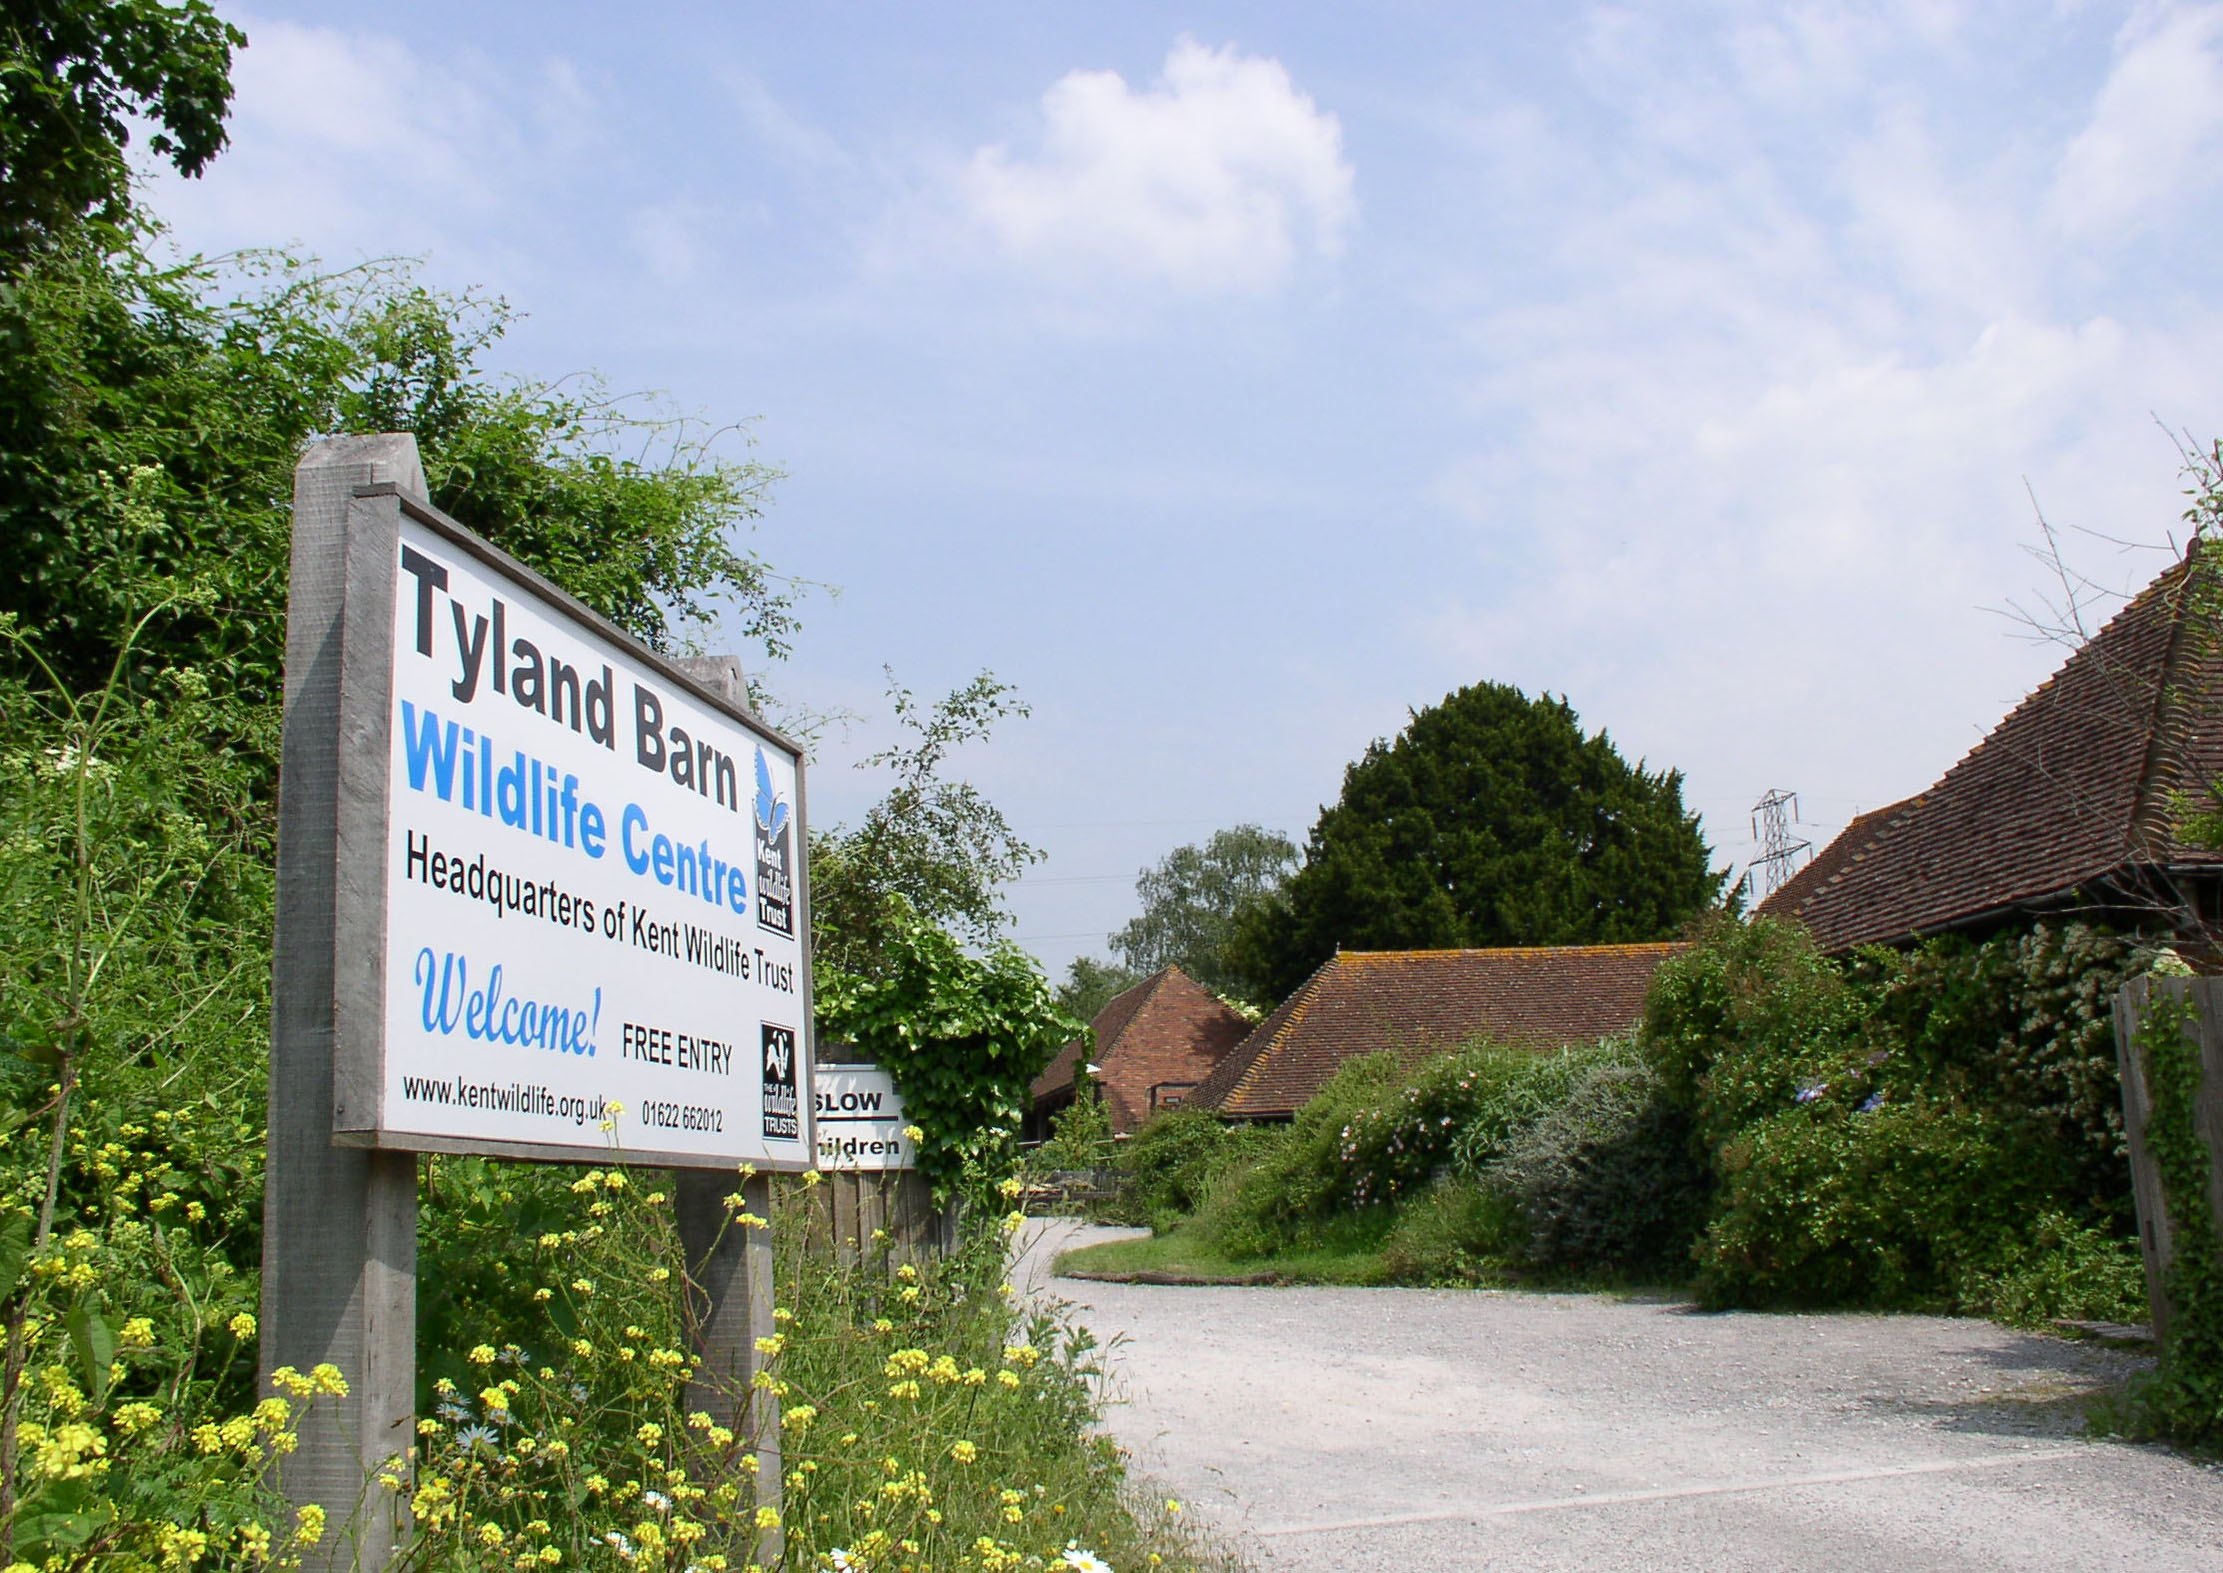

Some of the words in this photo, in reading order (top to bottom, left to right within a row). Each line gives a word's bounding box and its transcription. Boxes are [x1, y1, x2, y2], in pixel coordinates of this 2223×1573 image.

[402, 543, 615, 751] Tyland
[634, 683, 738, 812] Barn
[402, 700, 606, 859] Wildlife
[622, 803, 747, 914] Centre
[757, 838, 782, 870] Kent
[407, 829, 595, 933] Headquarters
[604, 901, 626, 941] of
[633, 906, 680, 959] Kent
[685, 923, 750, 980] Wildlife
[754, 948, 794, 994] Trust
[759, 870, 790, 906] wildlife
[760, 898, 787, 929] Trust
[415, 947, 602, 1057] Welcome!
[623, 1023, 672, 1065] FREE
[678, 1034, 733, 1076] ENTRY
[403, 1076, 606, 1126] www.kentwildlife.org.uk
[642, 1100, 679, 1129] 01622
[683, 1106, 723, 1133] 662012
[764, 1116, 798, 1135] TRUSTS
